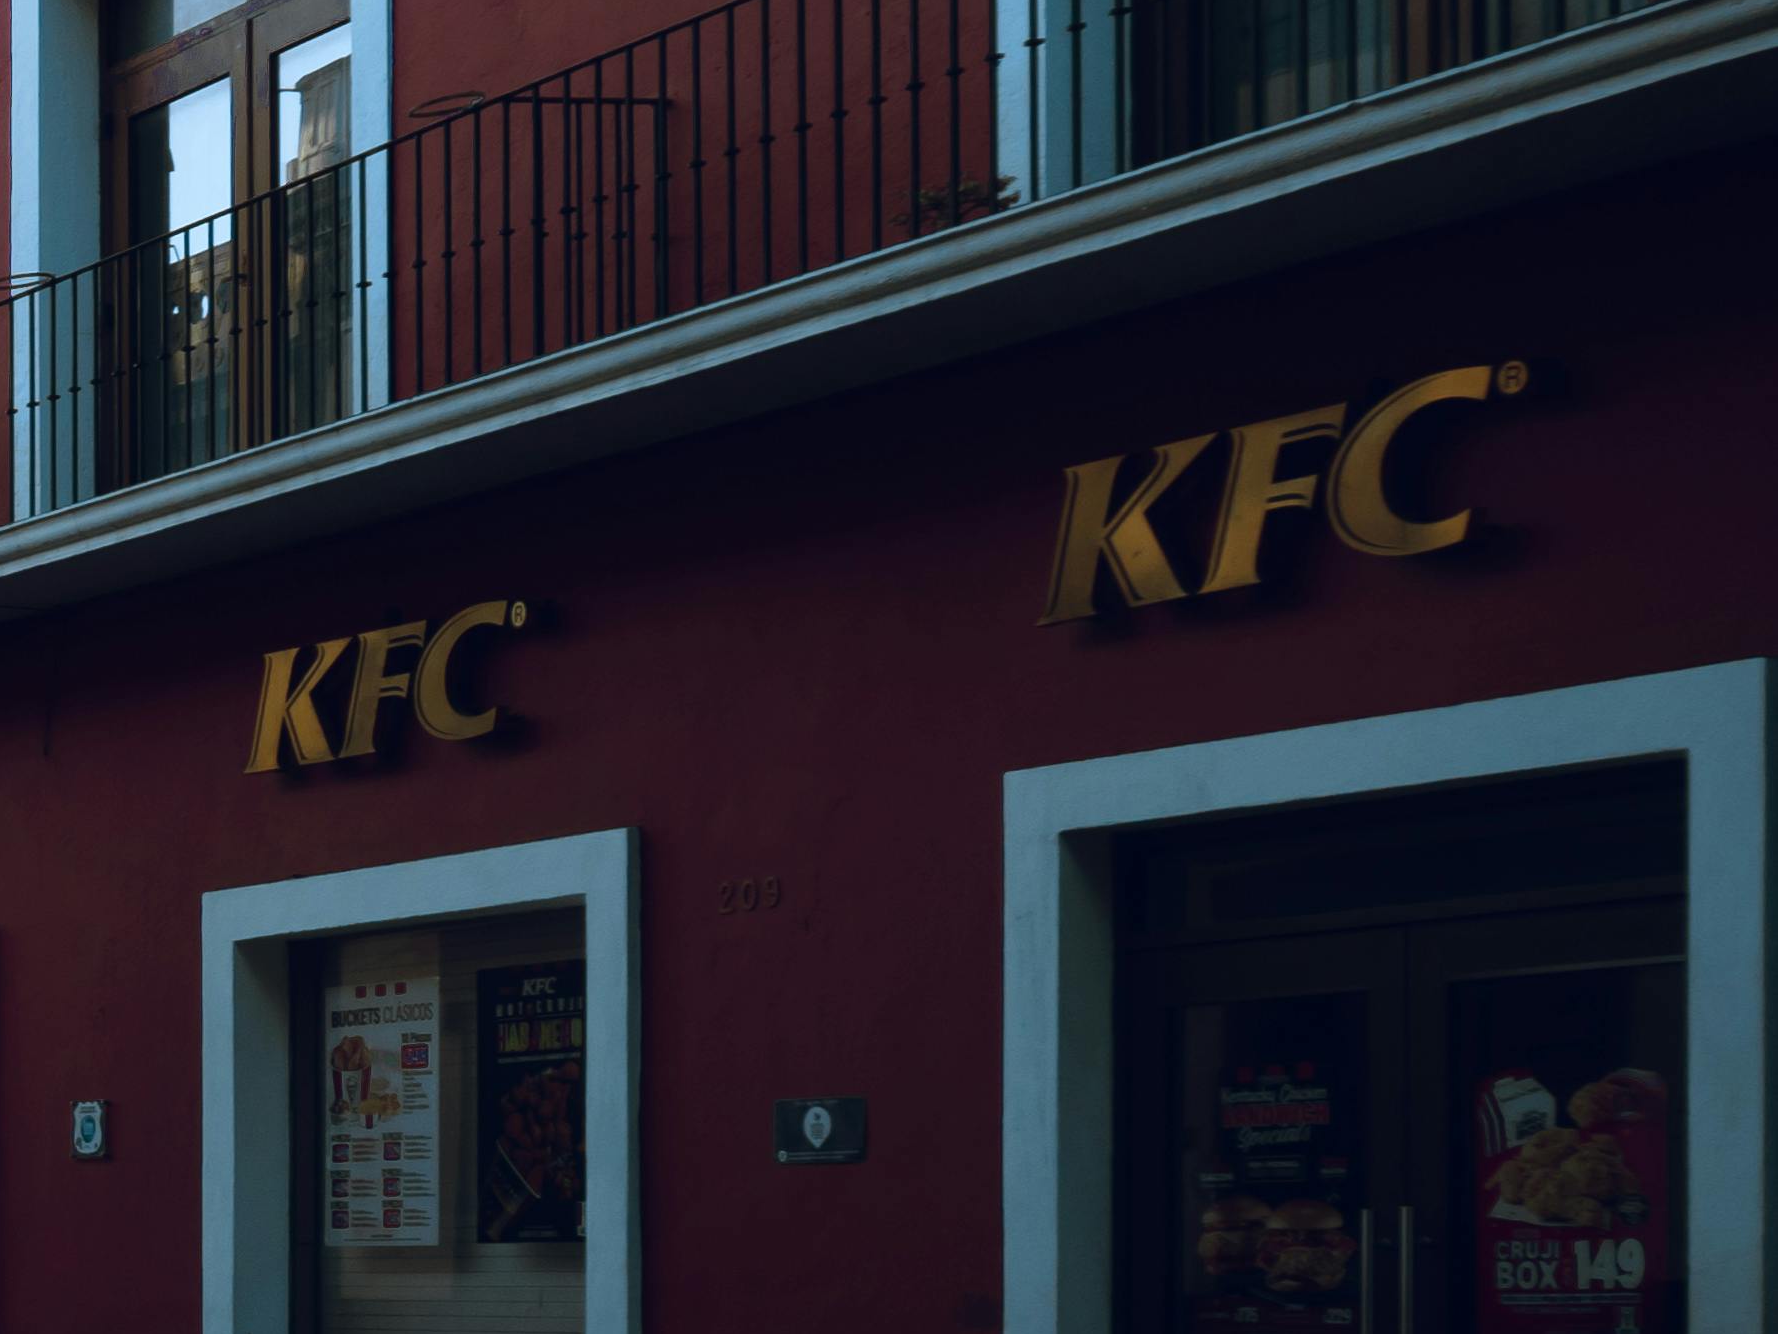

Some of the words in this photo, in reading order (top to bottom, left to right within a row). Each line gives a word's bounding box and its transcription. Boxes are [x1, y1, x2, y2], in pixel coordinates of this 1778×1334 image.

[1034, 363, 1493, 627] KFC
[244, 599, 509, 775] KFC
[716, 875, 782, 916] 209
[522, 976, 558, 996] KFC
[331, 1007, 381, 1029] BUCKETS
[382, 1000, 434, 1024] CLÁSICOS
[1495, 1240, 1560, 1260] CRUJI
[1573, 1238, 1646, 1290] 149
[1495, 1261, 1560, 1290] BOX
